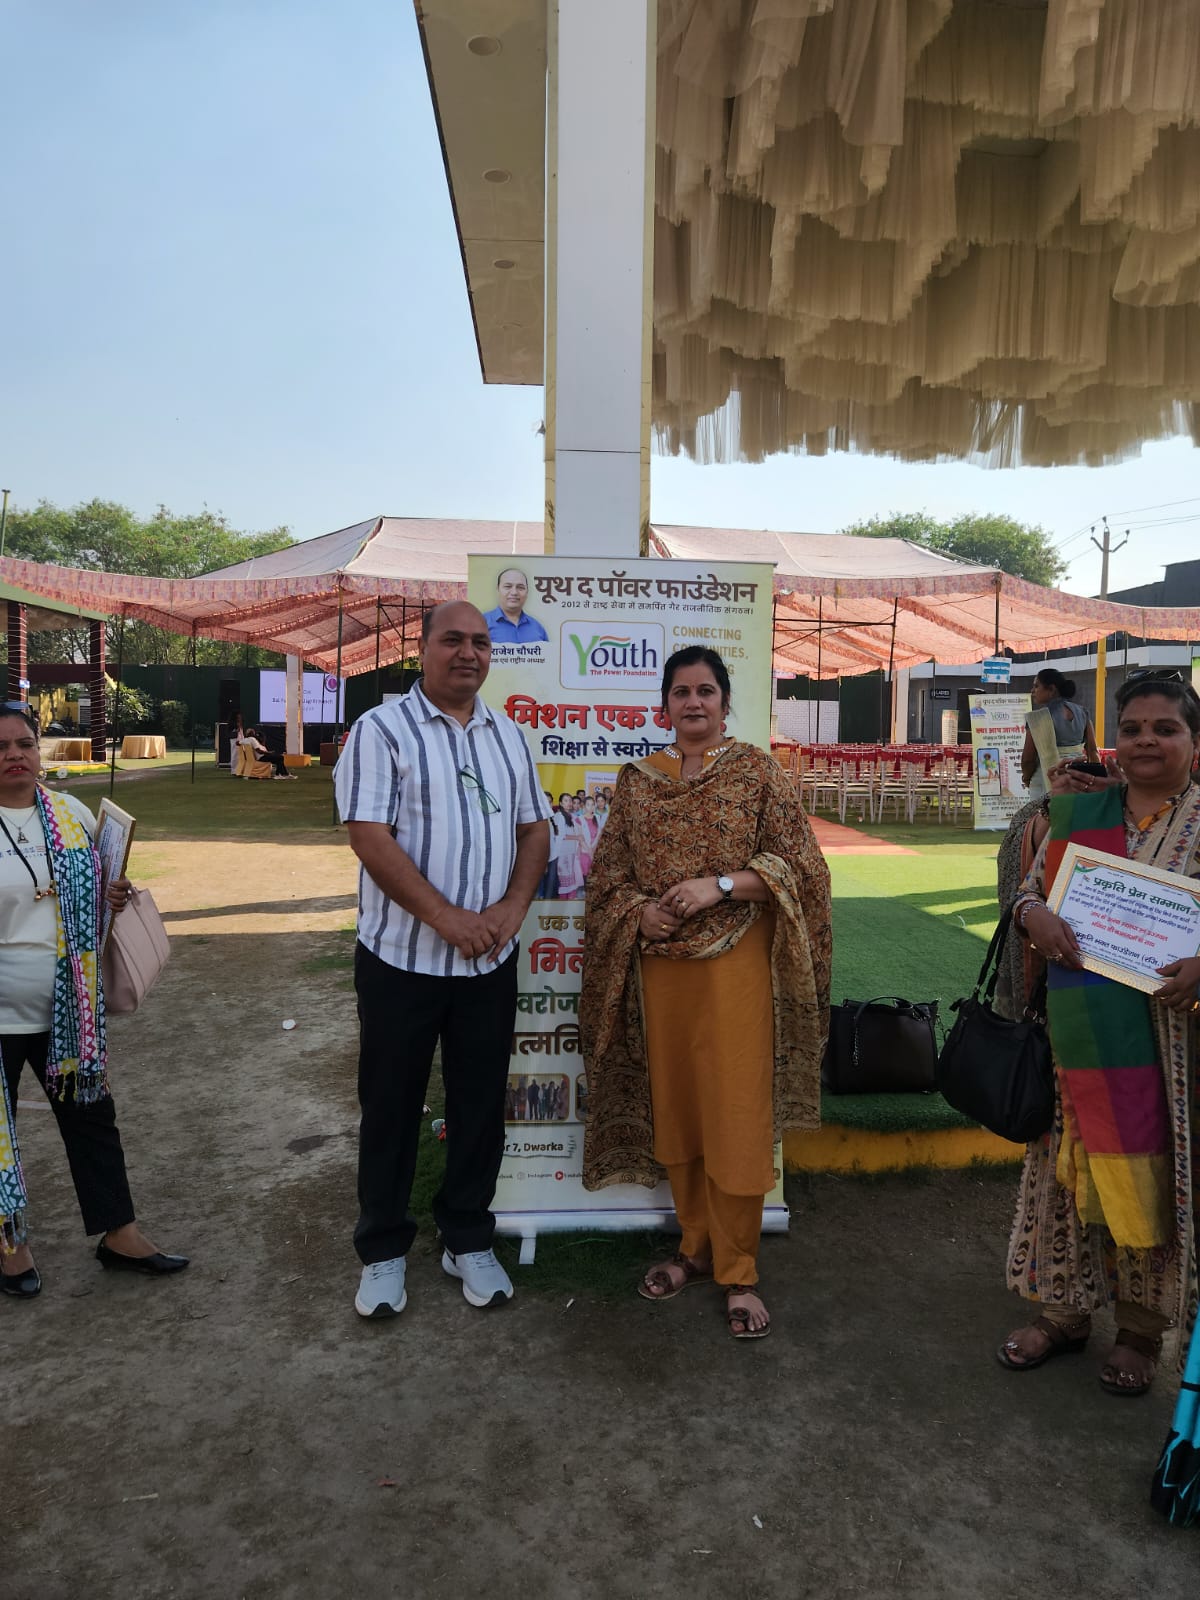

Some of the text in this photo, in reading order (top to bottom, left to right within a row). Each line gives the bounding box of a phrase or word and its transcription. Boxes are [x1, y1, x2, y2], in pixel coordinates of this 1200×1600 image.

[534, 570, 758, 604] यूथ द पॉवर फाउंडेशन
[682, 603, 721, 613] राजनीतिक
[672, 626, 742, 640] CONNECTING
[491, 645, 541, 656] राजेश चौधरी
[568, 633, 657, 676] Youth
[504, 694, 590, 730] मिशन
[594, 704, 648, 731] एक
[541, 735, 589, 758] शिक्षा
[592, 736, 609, 757] से
[1093, 875, 1127, 894] प्रकृति
[1128, 886, 1147, 901] प्रेम
[1149, 895, 1192, 916] सम्मान
[538, 915, 569, 931] एक
[512, 1143, 521, 1152] 7,
[524, 1142, 564, 1151] Dwarka
